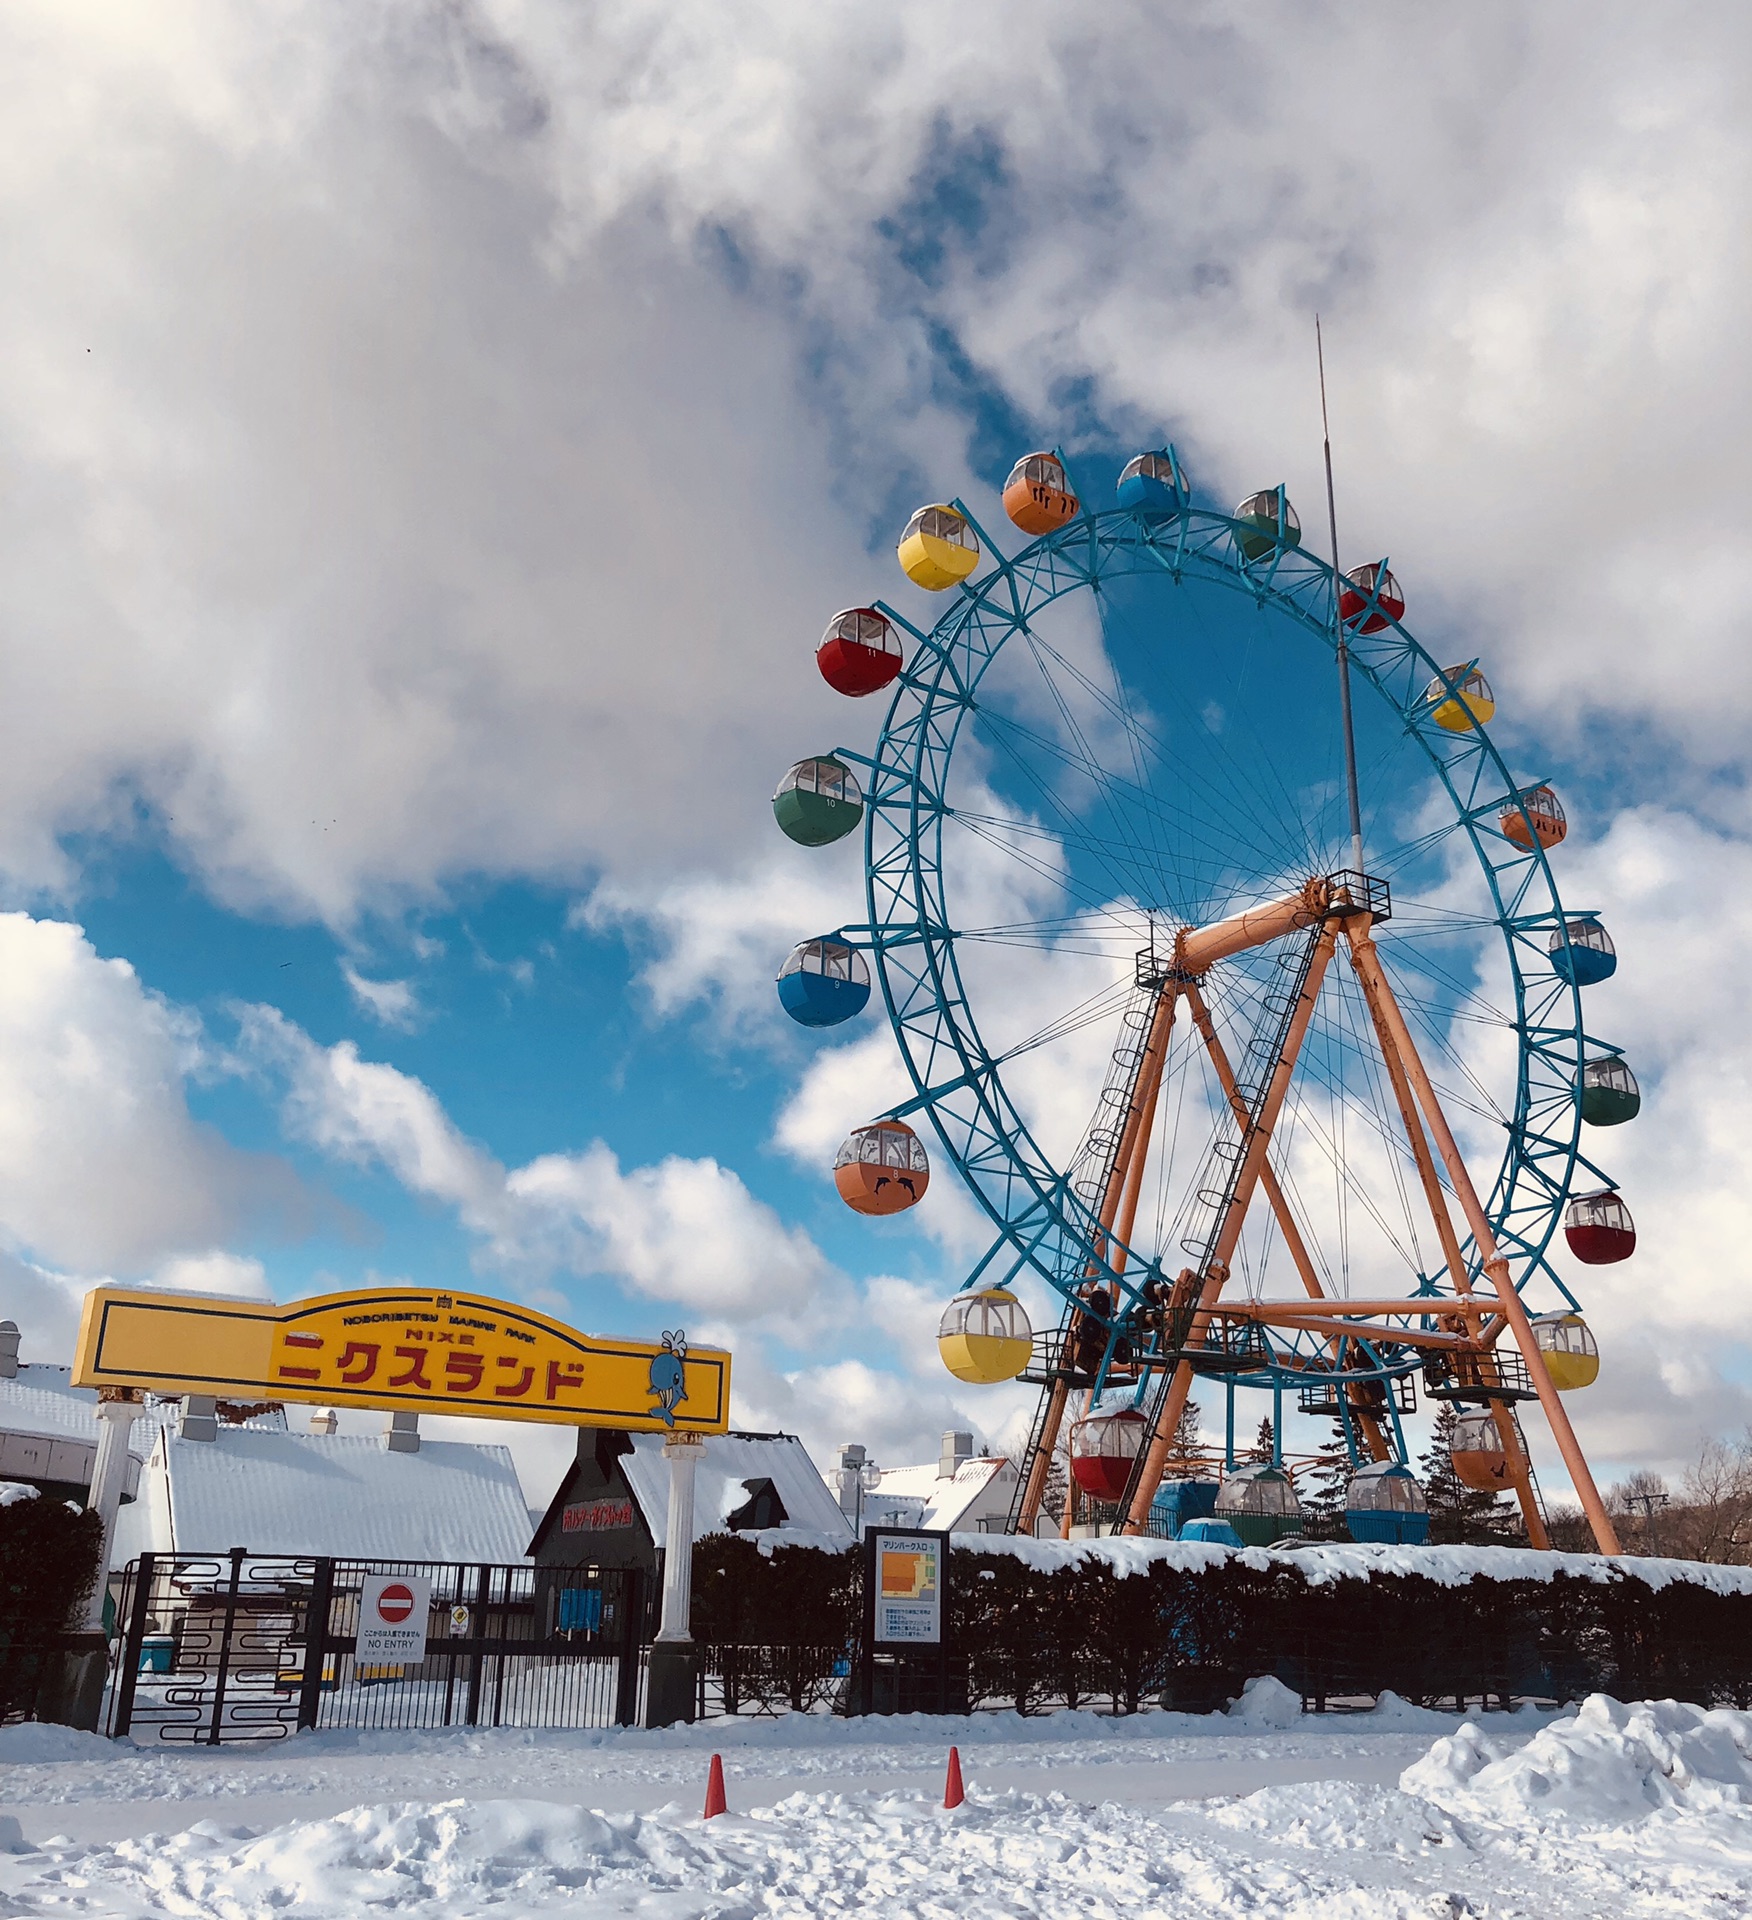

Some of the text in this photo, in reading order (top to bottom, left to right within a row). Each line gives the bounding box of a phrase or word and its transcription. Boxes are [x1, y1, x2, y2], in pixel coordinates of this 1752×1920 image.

[867, 648, 876, 658] 11
[826, 798, 836, 808] 10
[834, 980, 840, 989] 9
[893, 1169, 899, 1178] 8
[343, 1313, 537, 1345] NOBORIBETSU MARINE PARK
[405, 1328, 475, 1346] NIXE
[278, 1334, 585, 1400] ニクスランド
[883, 1541, 928, 1551] マリンパーク入口
[368, 1640, 414, 1649] NO ENTRY
